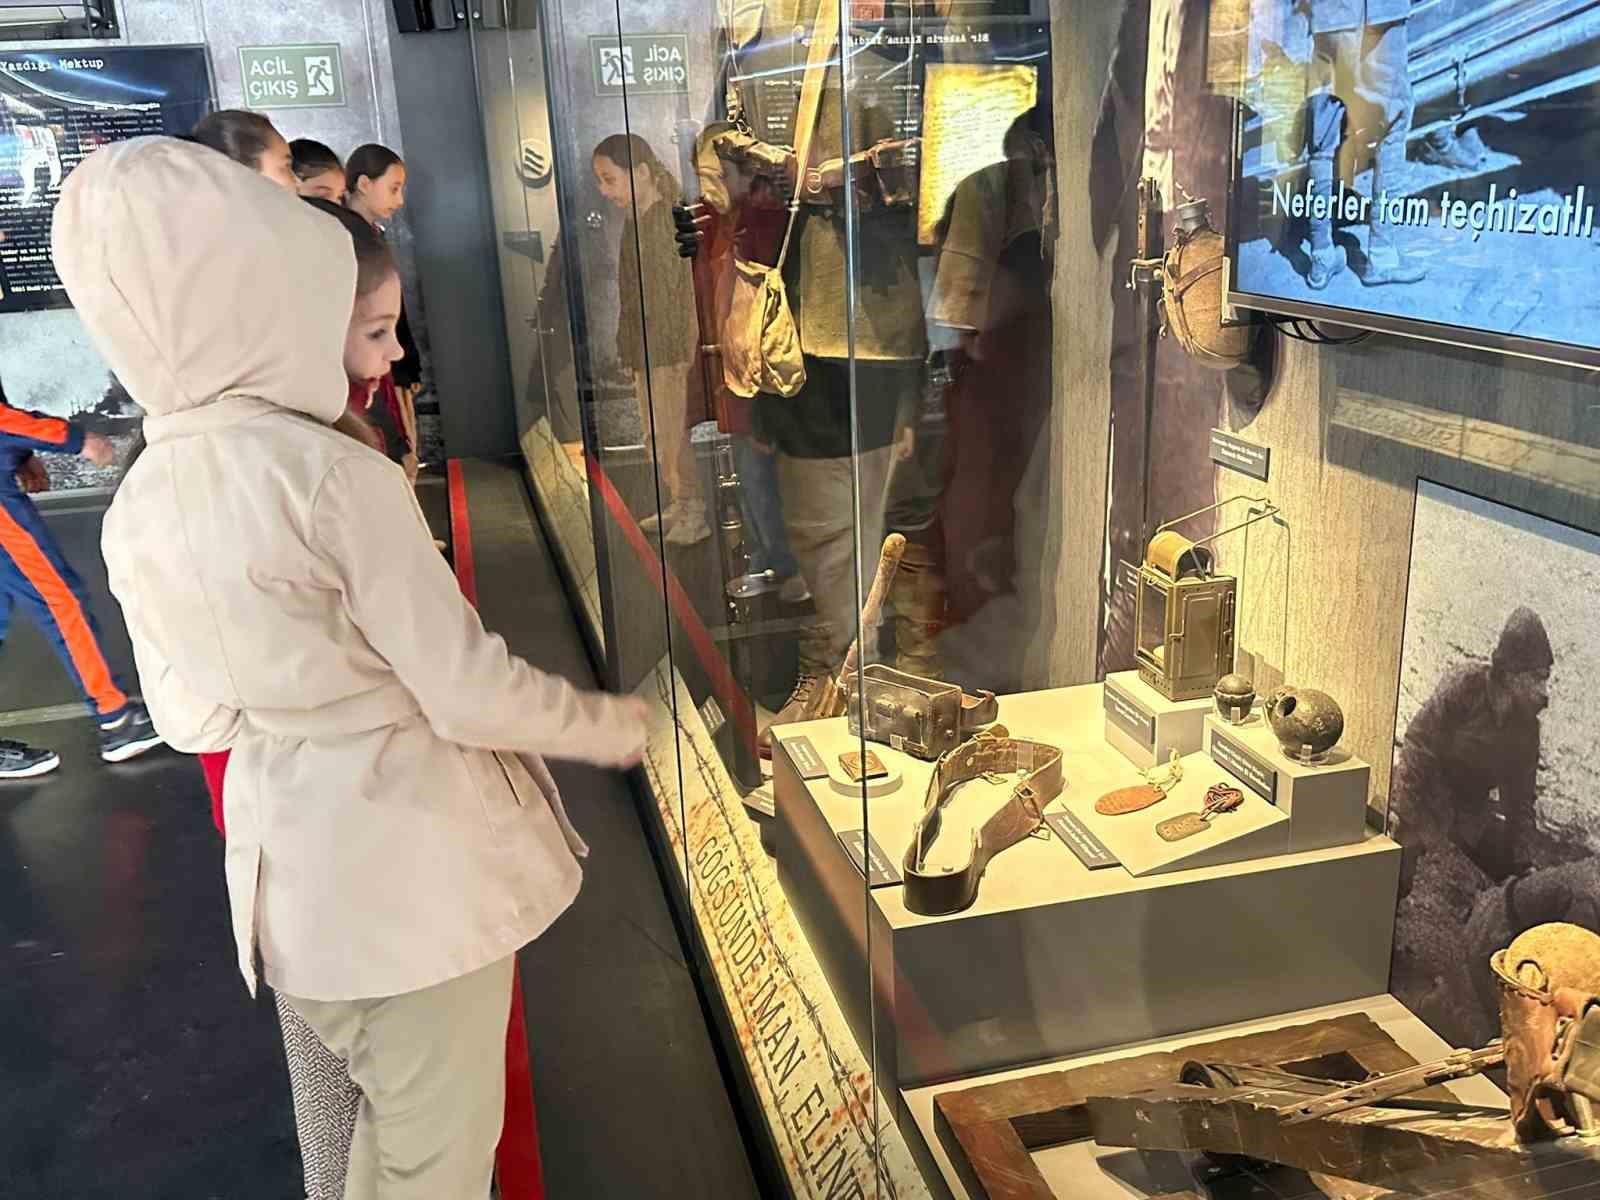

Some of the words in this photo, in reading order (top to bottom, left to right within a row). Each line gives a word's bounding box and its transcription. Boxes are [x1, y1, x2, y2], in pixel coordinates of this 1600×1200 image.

[59, 58, 104, 70] Mektup
[250, 56, 295, 76] ACİL
[249, 79, 299, 100] ÇIKIŞ
[1271, 179, 1371, 222] Neferler
[1379, 193, 1429, 226] tam
[1440, 183, 1593, 241] teçhizatlı
[695, 835, 767, 989] GÖĞSÜNDE
